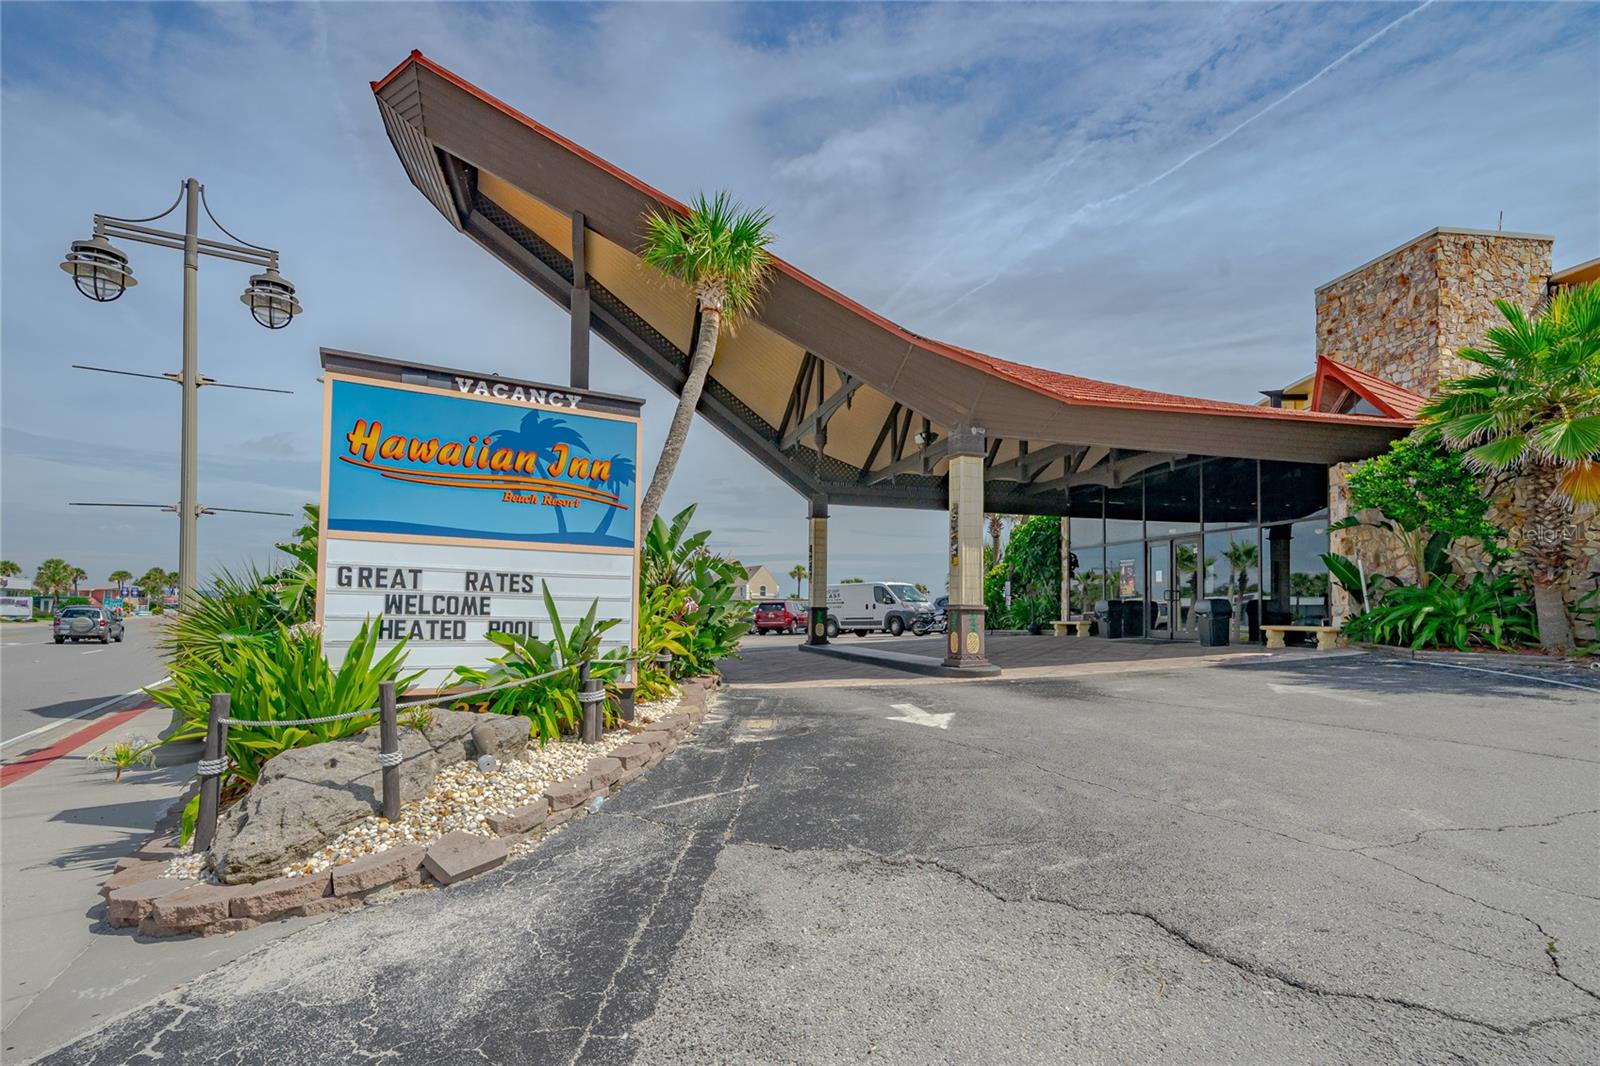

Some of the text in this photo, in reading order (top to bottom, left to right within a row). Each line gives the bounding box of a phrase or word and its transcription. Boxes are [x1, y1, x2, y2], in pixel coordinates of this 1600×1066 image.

[456, 377, 582, 409] VACANCY
[346, 418, 611, 481] Hawaiian Inn
[502, 491, 580, 507] Beach Resort
[337, 566, 534, 593] GREAT RATES
[384, 594, 491, 616] WELCOME
[379, 619, 466, 640] HEATED
